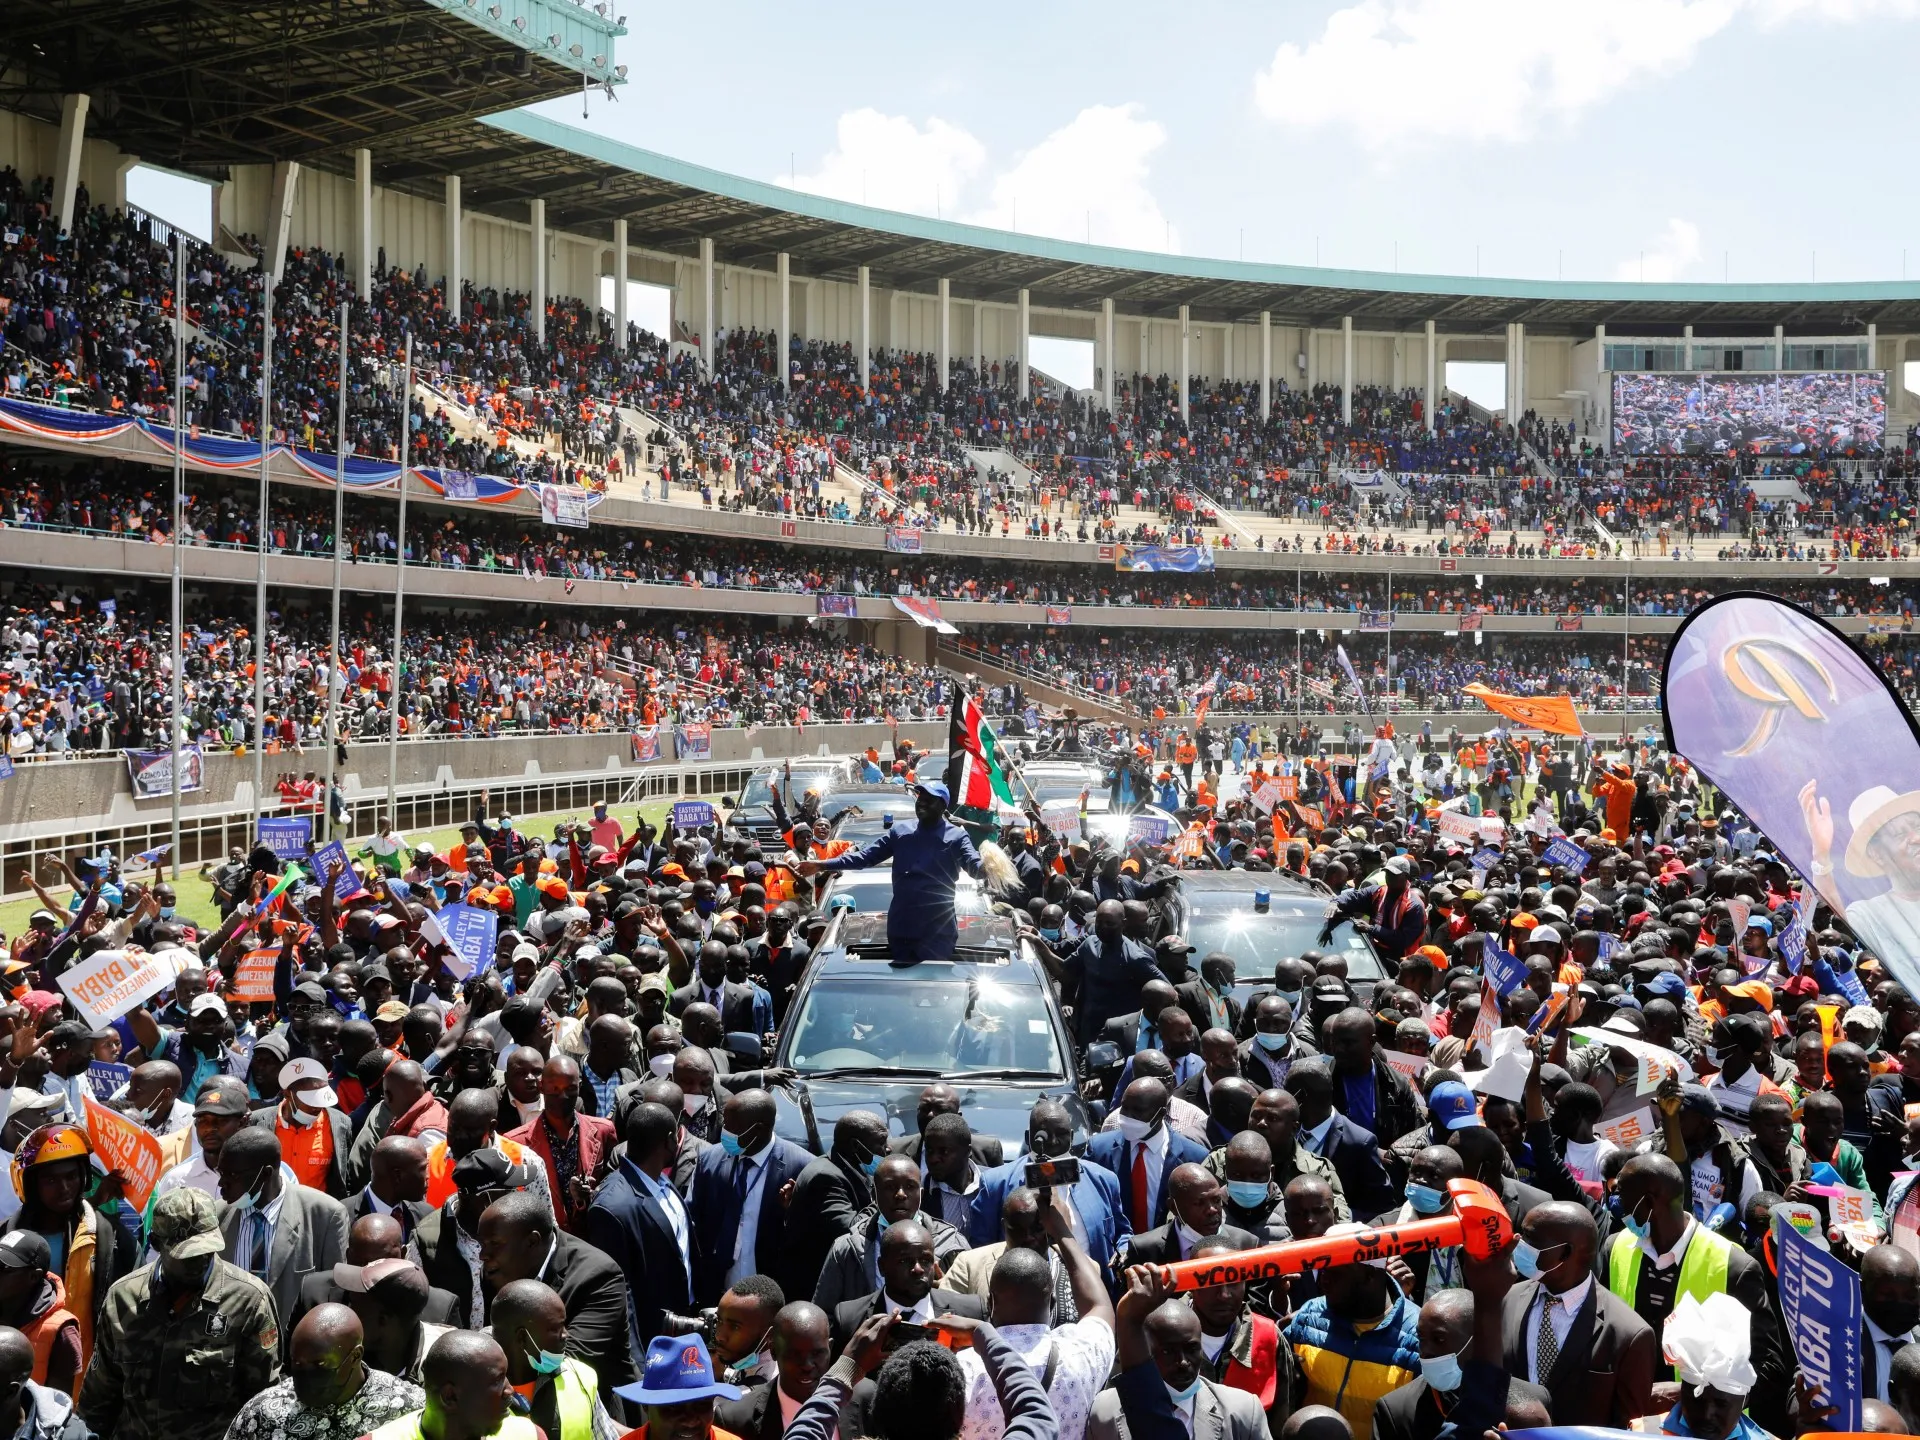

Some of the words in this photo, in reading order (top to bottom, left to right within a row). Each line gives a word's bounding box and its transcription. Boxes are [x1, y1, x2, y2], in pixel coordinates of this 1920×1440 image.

[1818, 563, 1838, 575] 7
[678, 805, 702, 813] EASTERN
[678, 813, 698, 823] BABA
[699, 812, 709, 821] TU
[1057, 819, 1079, 832] BABA
[291, 837, 304, 849] TU
[1554, 840, 1578, 858] NAIROBI
[1549, 846, 1569, 865] BABA
[1568, 859, 1580, 871] TU
[468, 912, 486, 930] TU
[71, 960, 127, 1004] BABA
[90, 965, 160, 1015] INAWEZEKANA
[115, 1071, 125, 1081] NI
[92, 1109, 137, 1159] BABA
[135, 1142, 159, 1182] NA
[1785, 1238, 1800, 1264] NI
[1193, 1261, 1281, 1287] UMOJA
[1801, 1251, 1834, 1309] TU
